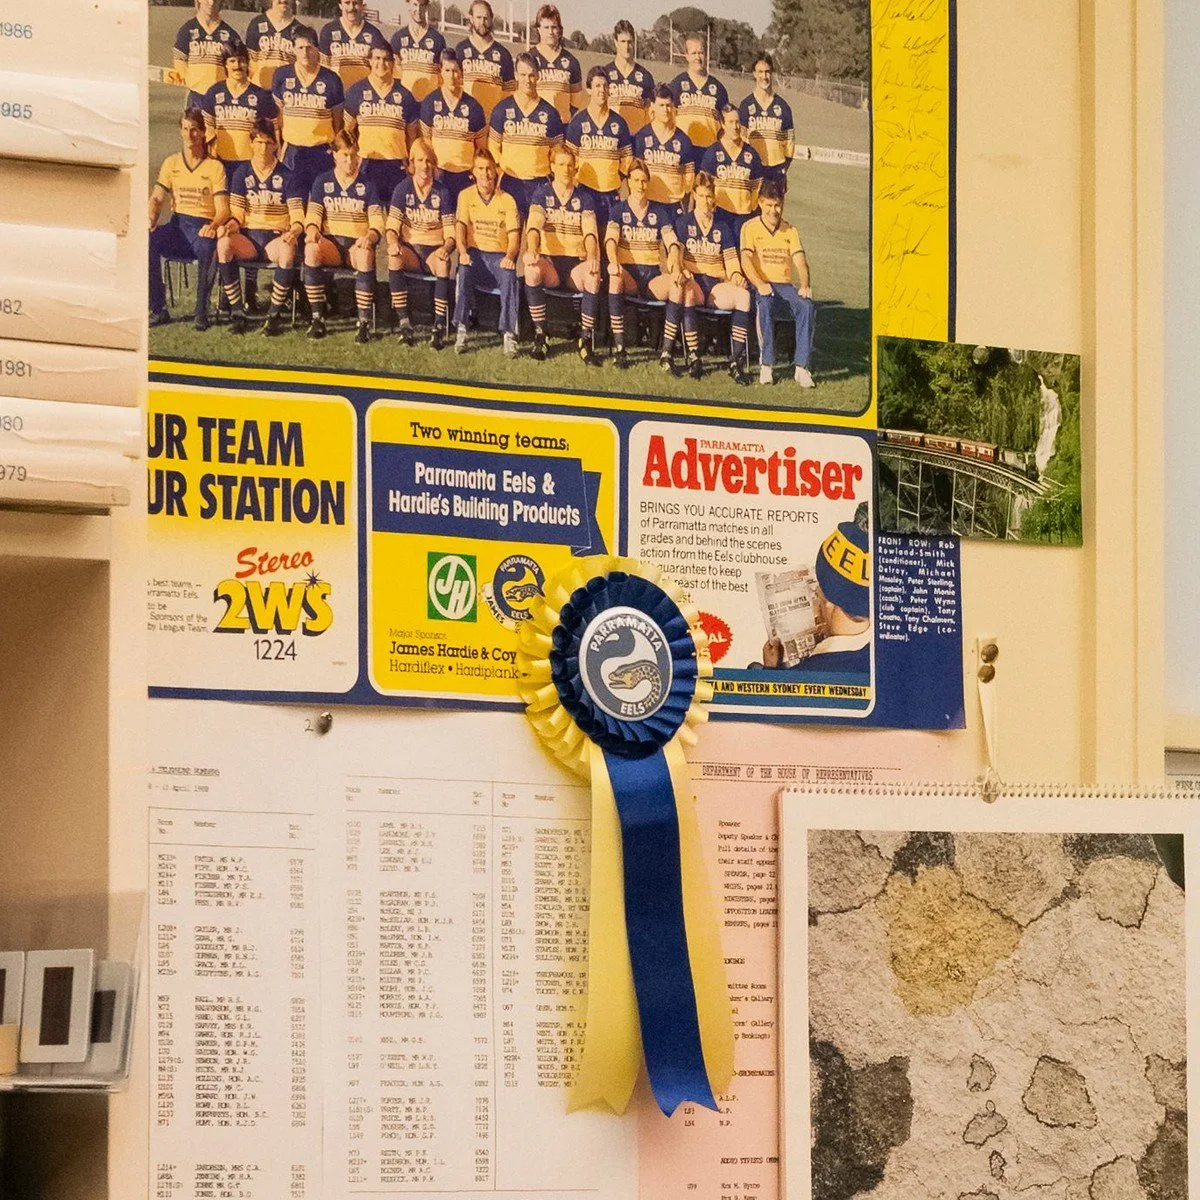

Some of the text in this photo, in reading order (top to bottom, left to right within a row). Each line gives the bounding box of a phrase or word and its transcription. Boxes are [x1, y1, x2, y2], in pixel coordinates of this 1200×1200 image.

[198, 416, 304, 467] TEAM
[410, 422, 442, 440] Two
[447, 426, 510, 449] winning
[700, 439, 765, 453] PARRAMATTA
[414, 461, 555, 495] Parramatta Eels &
[642, 434, 863, 500] Advertiser
[199, 473, 345, 525] STATION
[388, 489, 581, 526] Hardie's Building Products
[640, 501, 819, 524] BRINGS YOU ACCURATE REPORTS
[640, 517, 774, 536] of Parramatta matches in all
[640, 533, 782, 551] grades and behind the scenes
[235, 546, 314, 579] Stereo
[640, 548, 787, 565] action from the Eels clubhouse
[708, 565, 742, 579] to keep
[700, 579, 749, 593] of the best
[212, 577, 334, 637] 2WS
[590, 616, 663, 652] PARRAMATTA
[254, 639, 298, 661] 1224
[390, 641, 435, 656] James
[437, 643, 478, 659] Hardie
[481, 647, 490, 659] &
[389, 659, 445, 675] Hardiflex
[721, 682, 866, 697] AND WESTERN SYDNEY EVERY WEDNESDAY
[620, 702, 646, 714] EELS
